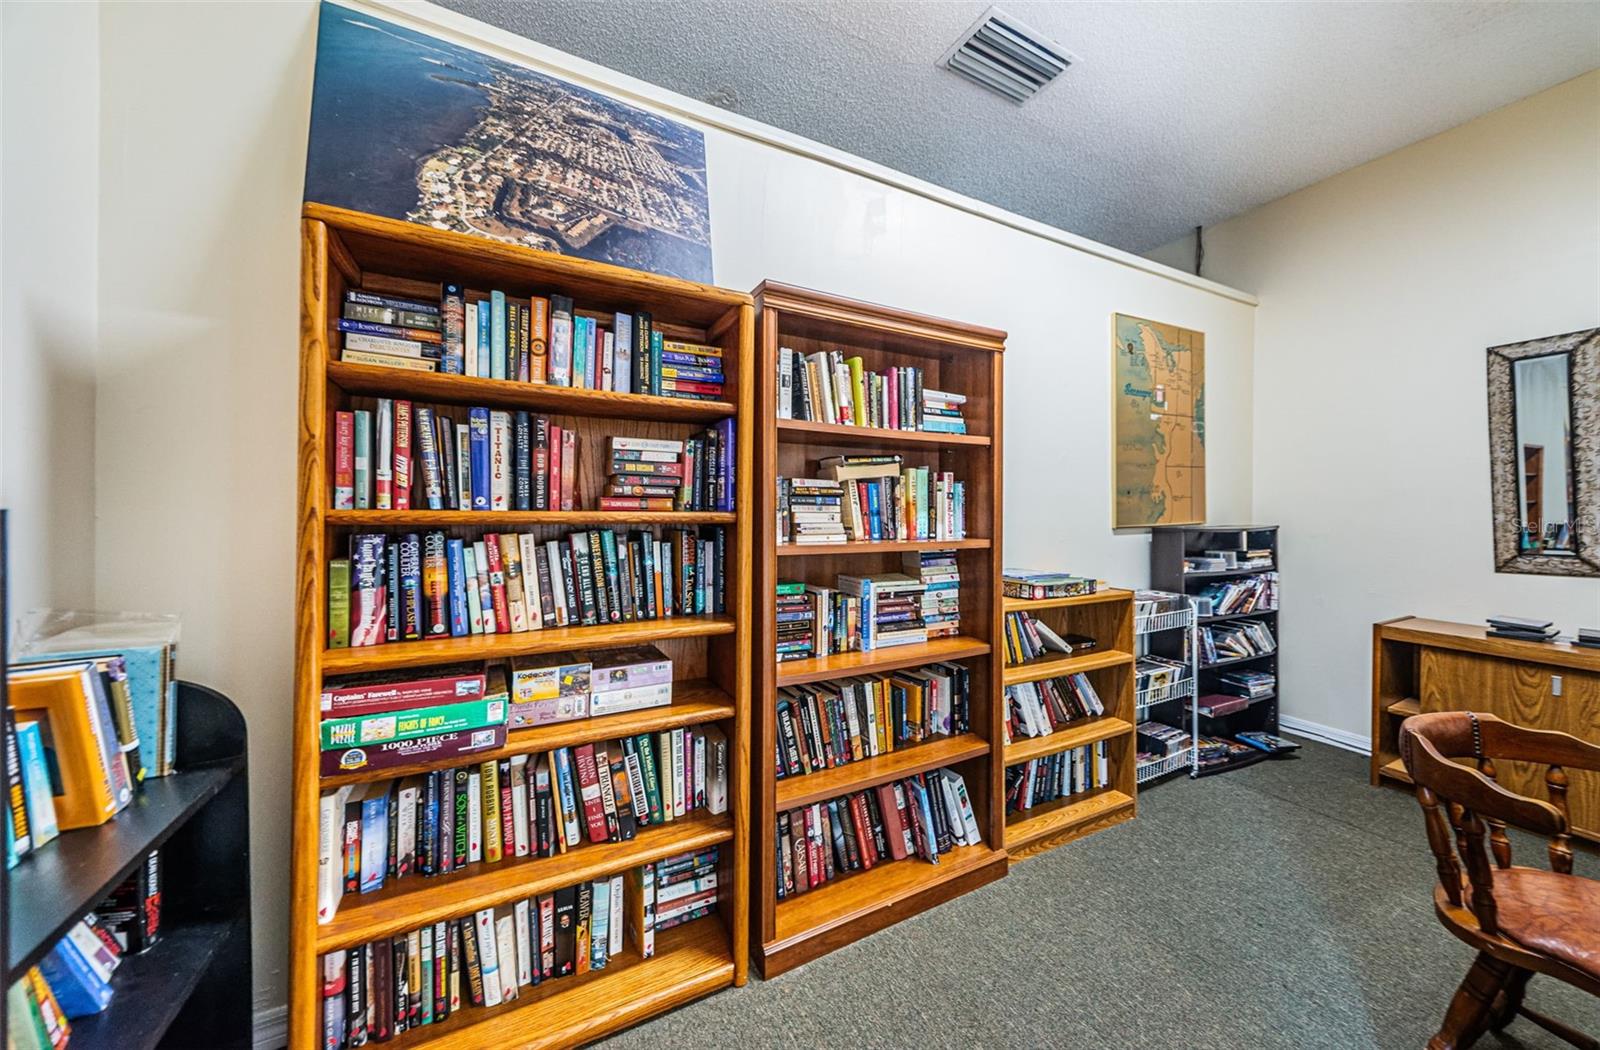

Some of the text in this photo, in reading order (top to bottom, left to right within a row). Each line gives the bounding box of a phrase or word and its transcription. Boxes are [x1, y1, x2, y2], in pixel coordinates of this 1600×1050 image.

[396, 404, 408, 420] JAMES
[396, 420, 408, 448] PATTERSON
[494, 428, 502, 480] TITANIC
[536, 470, 544, 508] WOODWARD
[400, 542, 410, 577] COULTER
[410, 541, 420, 576] CATHERINE
[425, 536, 436, 568] COULTER
[435, 534, 444, 570] CATHERINE
[590, 534, 605, 587] SIDNEY SHELDON
[581, 565, 589, 577] END
[406, 589, 416, 625] WHIPLASH
[584, 590, 592, 605] WARS
[330, 722, 356, 733] PUZZLE
[330, 735, 355, 745] PUZZLE
[380, 740, 414, 751] 1000
[416, 732, 459, 744] PIECE
[643, 738, 648, 748] On
[484, 764, 494, 781] TONY
[577, 755, 588, 784] IRVING
[585, 756, 596, 778] JOHN
[645, 756, 653, 771] Fields
[457, 794, 466, 813] SON
[486, 784, 495, 815] ROBBINS
[585, 798, 602, 806] UNTIL
[600, 770, 614, 810] TRIANGLE
[502, 790, 513, 844] LINDA HOWARD
[588, 813, 604, 821] FIND
[457, 824, 466, 856] WITCH
[795, 838, 807, 875] CAESAR
[580, 890, 590, 920] DEAVER
